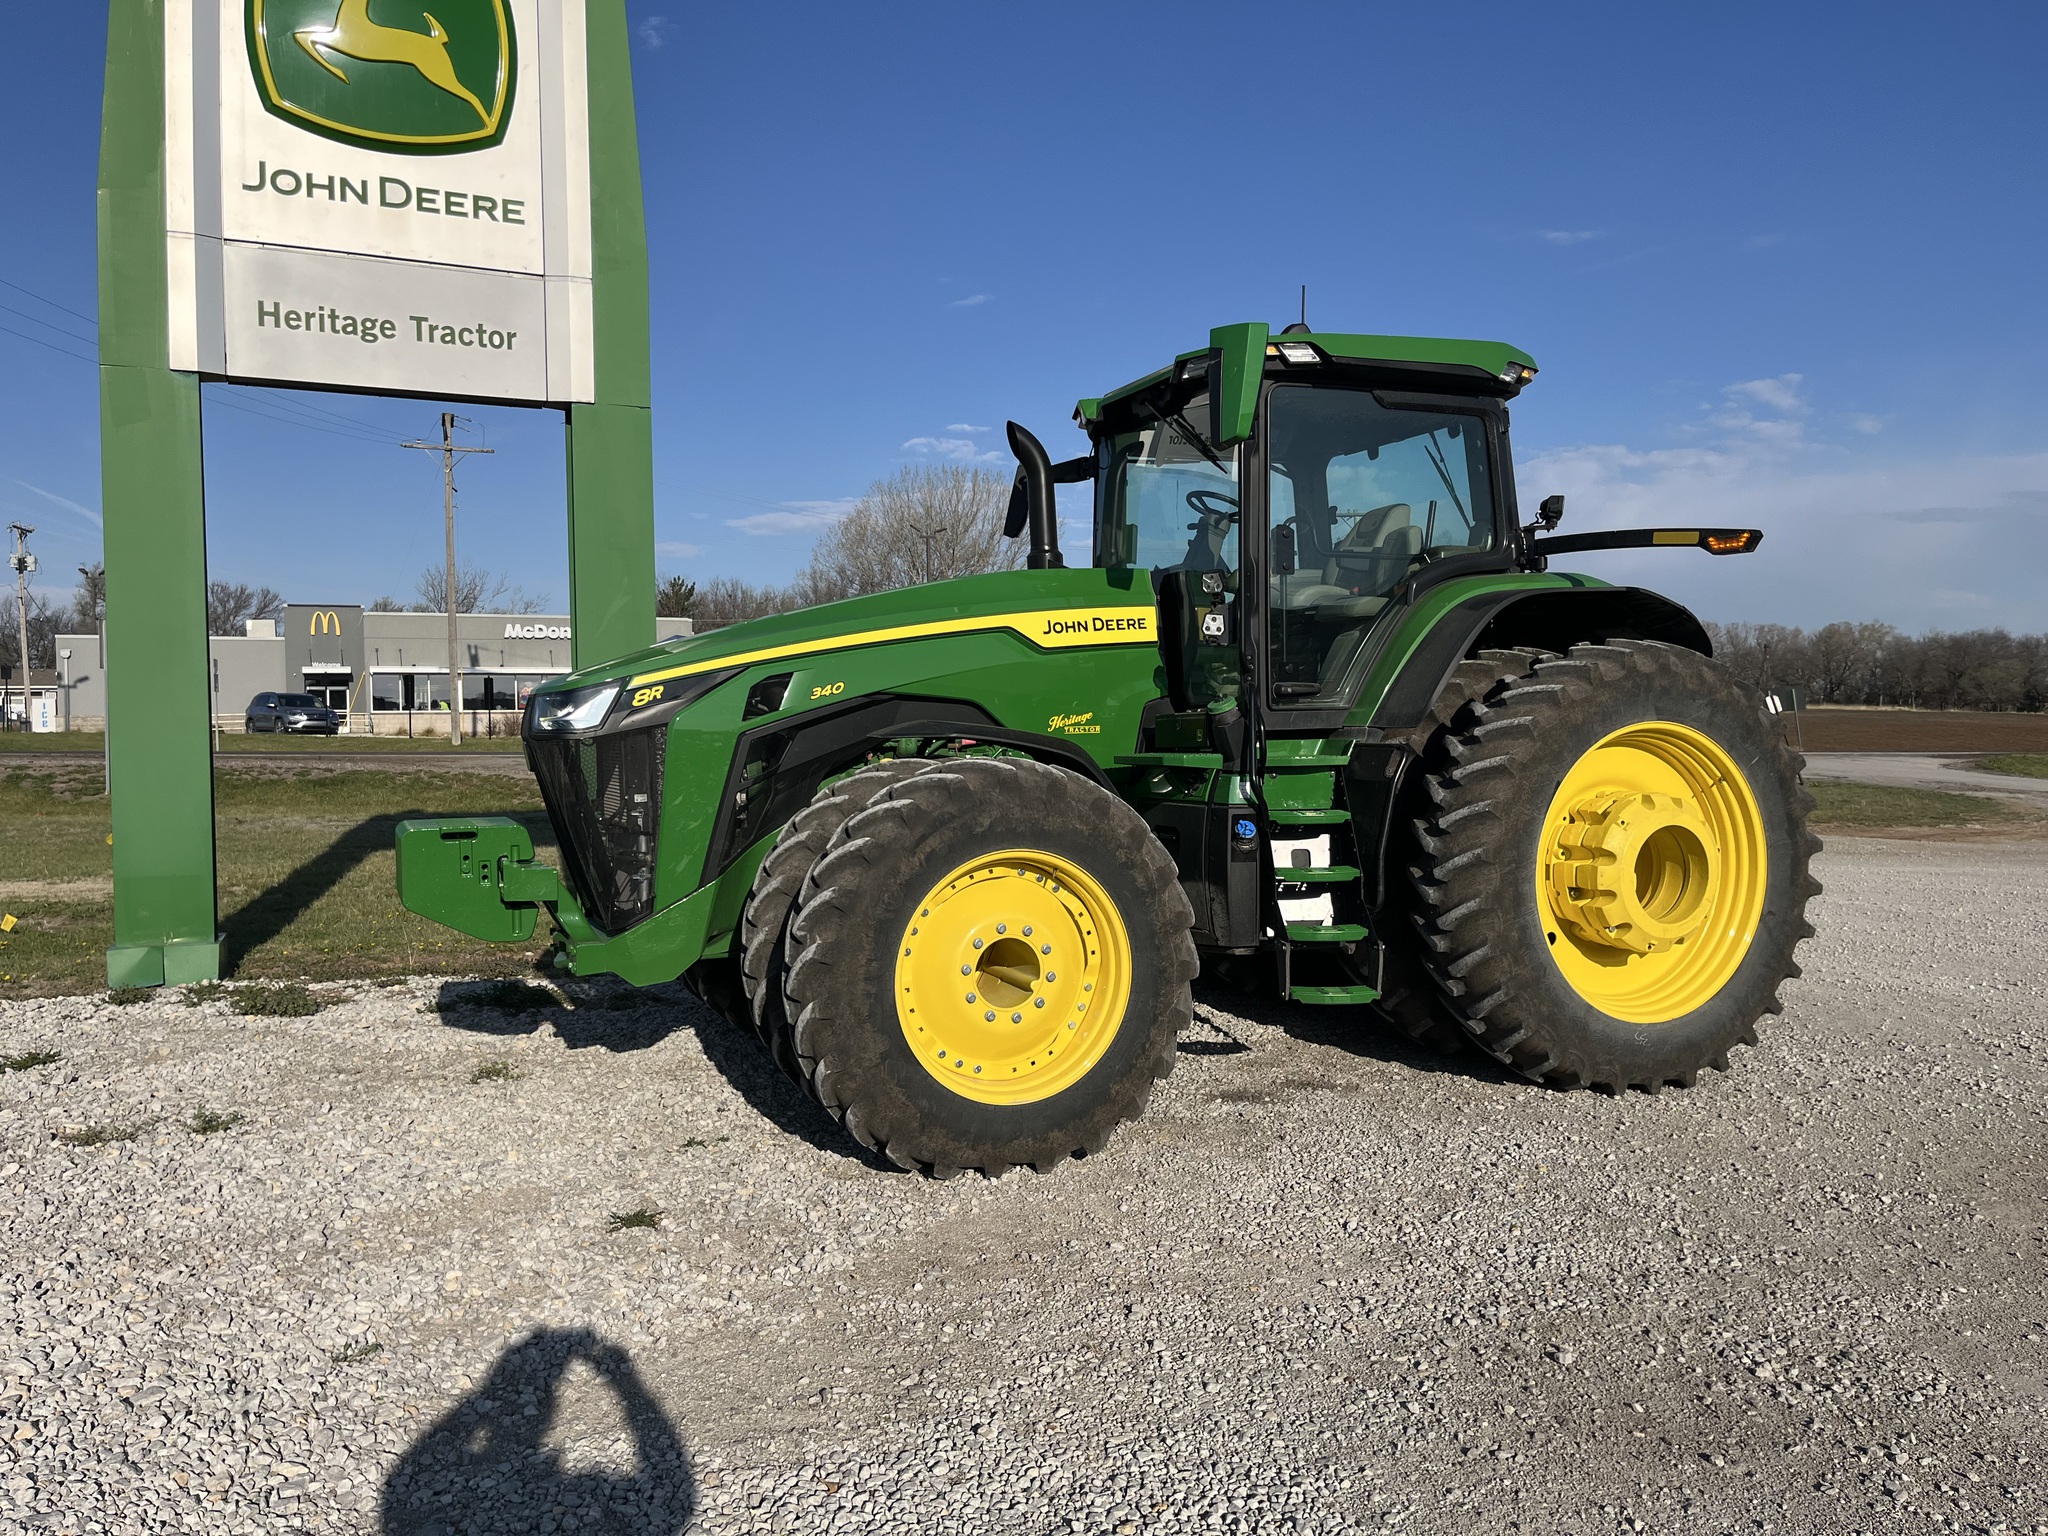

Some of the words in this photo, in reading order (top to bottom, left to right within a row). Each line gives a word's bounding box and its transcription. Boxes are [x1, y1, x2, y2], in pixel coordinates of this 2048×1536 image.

[242, 160, 369, 206] JOHN
[379, 176, 525, 225] DEERE
[257, 300, 397, 344] Heritage
[409, 315, 517, 350] Tractor
[504, 623, 572, 640] McDon
[1043, 620, 1088, 635] JOHN
[1092, 617, 1147, 632] DEERE
[631, 685, 664, 707] 8R
[810, 681, 845, 700] 340
[1047, 711, 1093, 732] Heritage
[1064, 725, 1100, 734] TRACTOR
